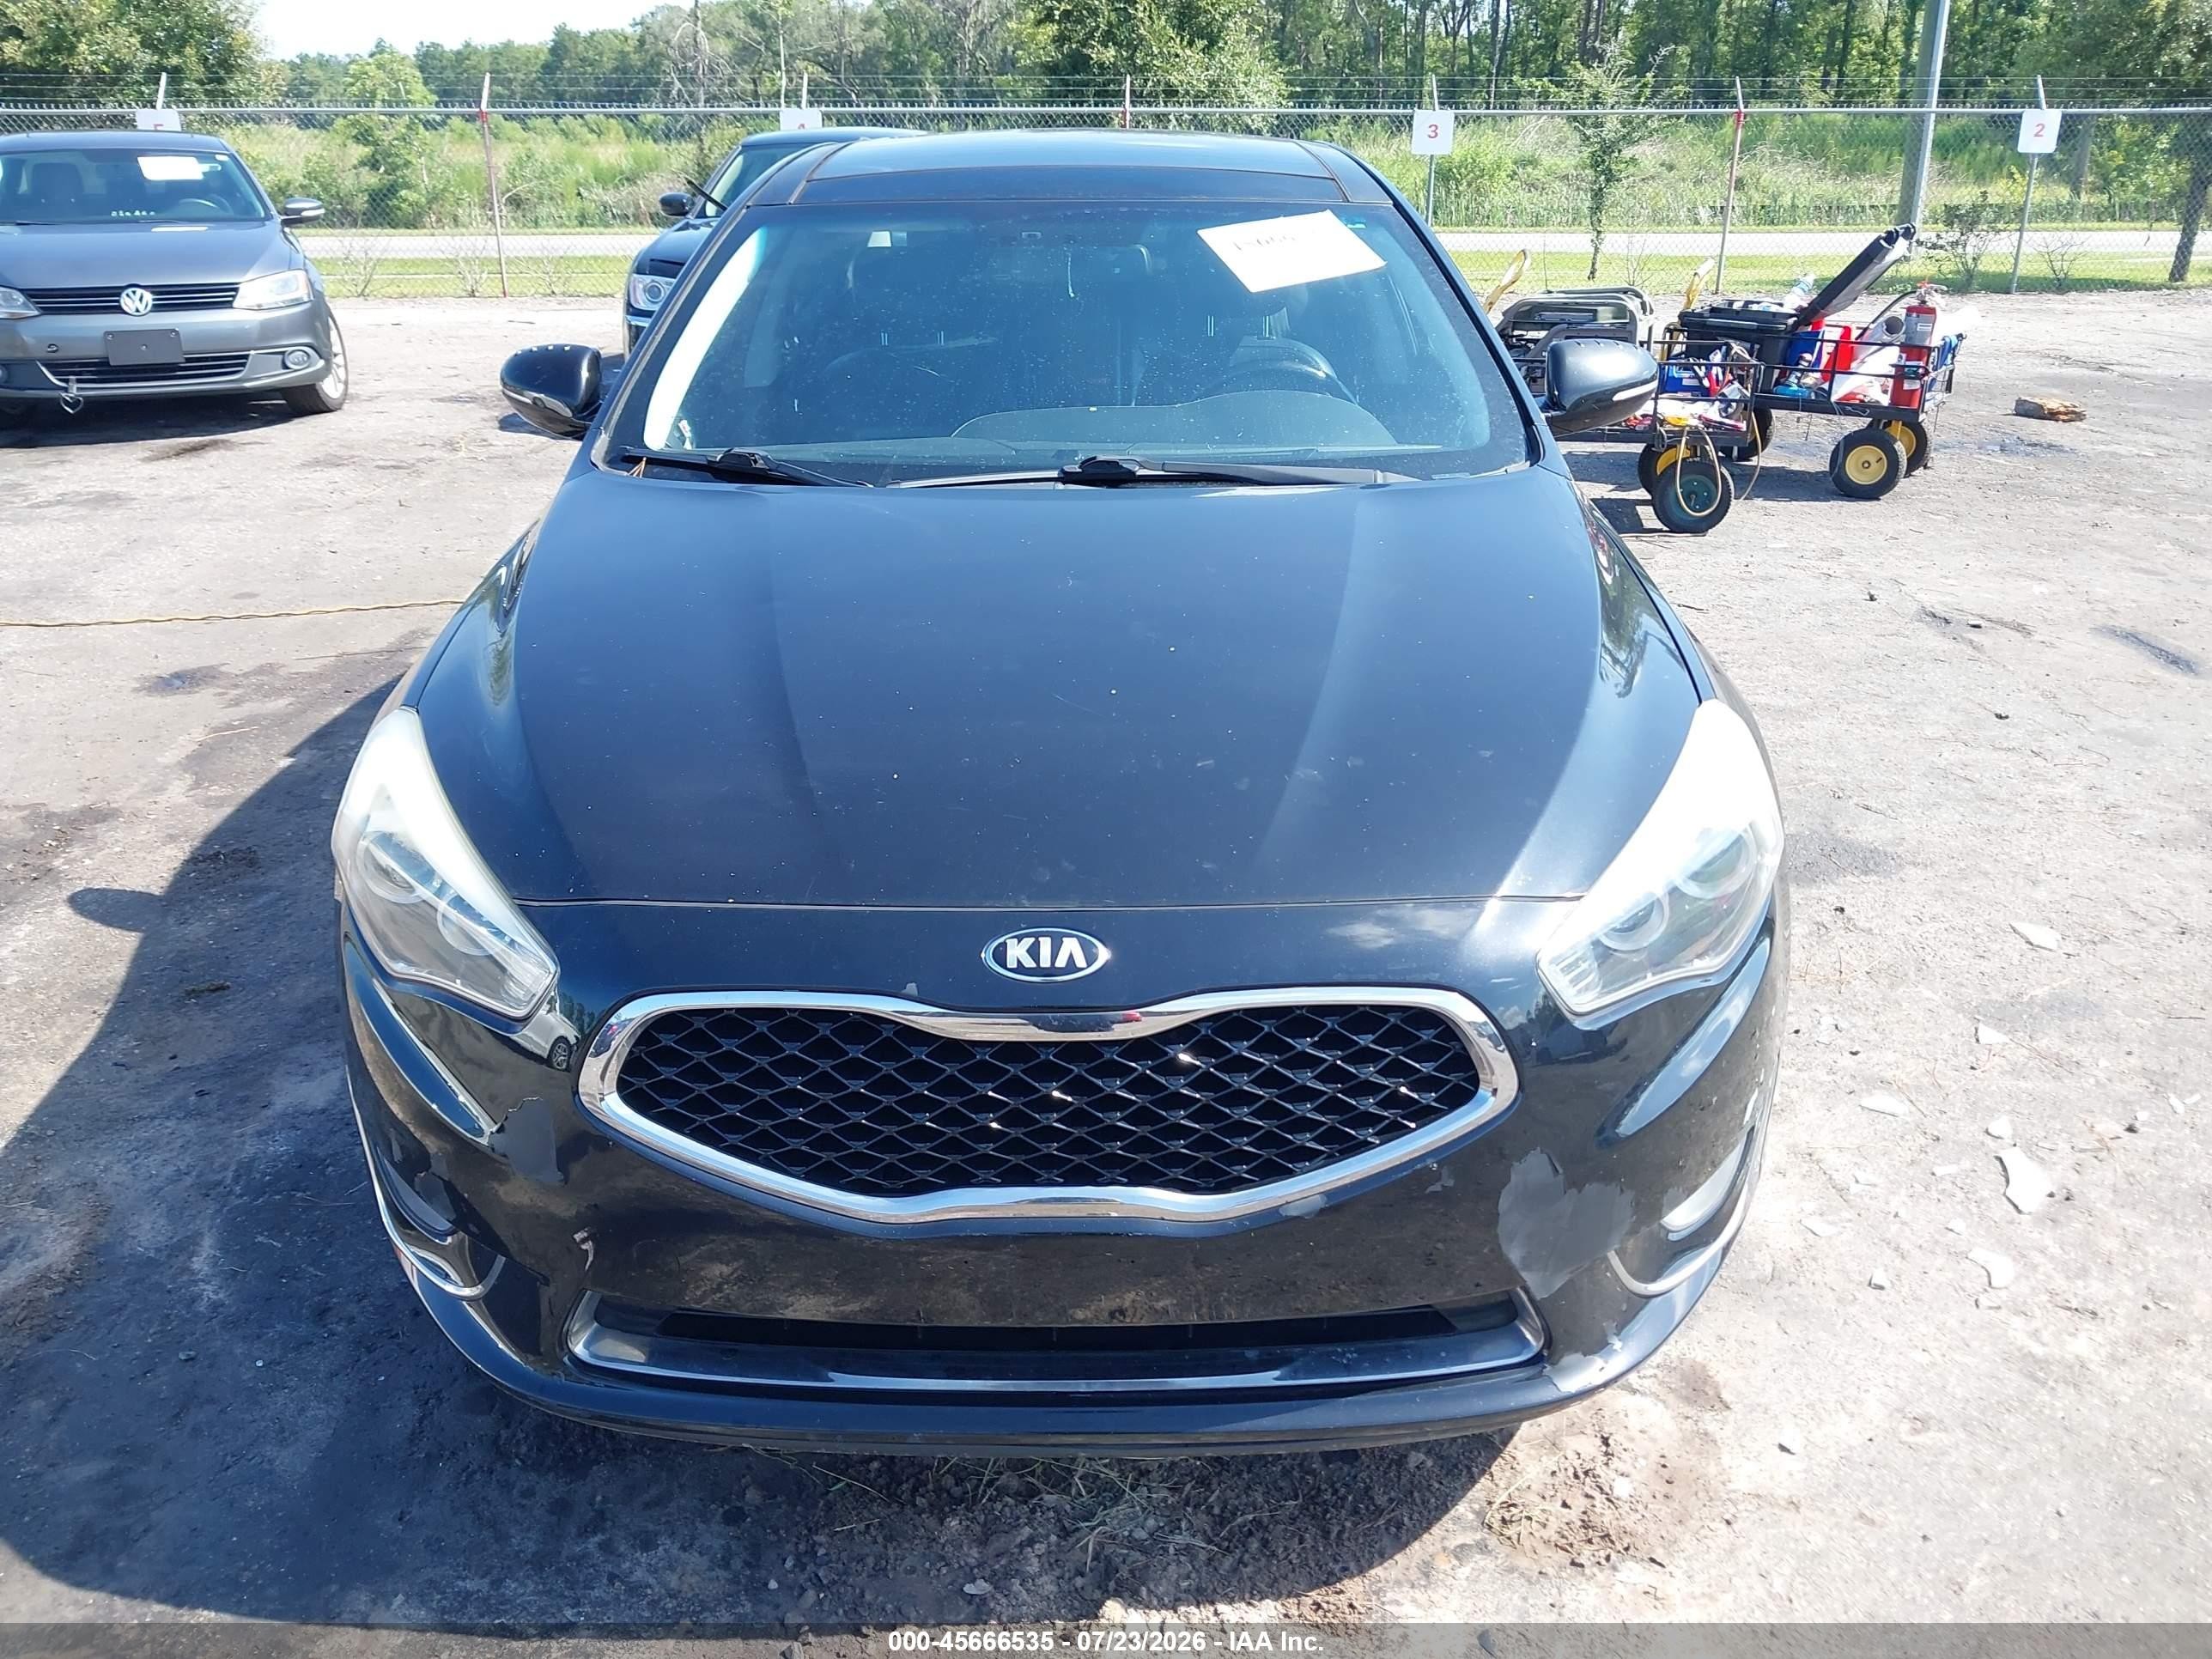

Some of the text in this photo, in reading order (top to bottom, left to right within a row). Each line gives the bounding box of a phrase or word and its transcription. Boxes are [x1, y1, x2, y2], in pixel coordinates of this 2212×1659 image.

[1428, 124, 1438, 139] 3
[2033, 123, 2045, 137] 2
[122, 289, 151, 314] VW
[1006, 936, 1088, 969] KIA
